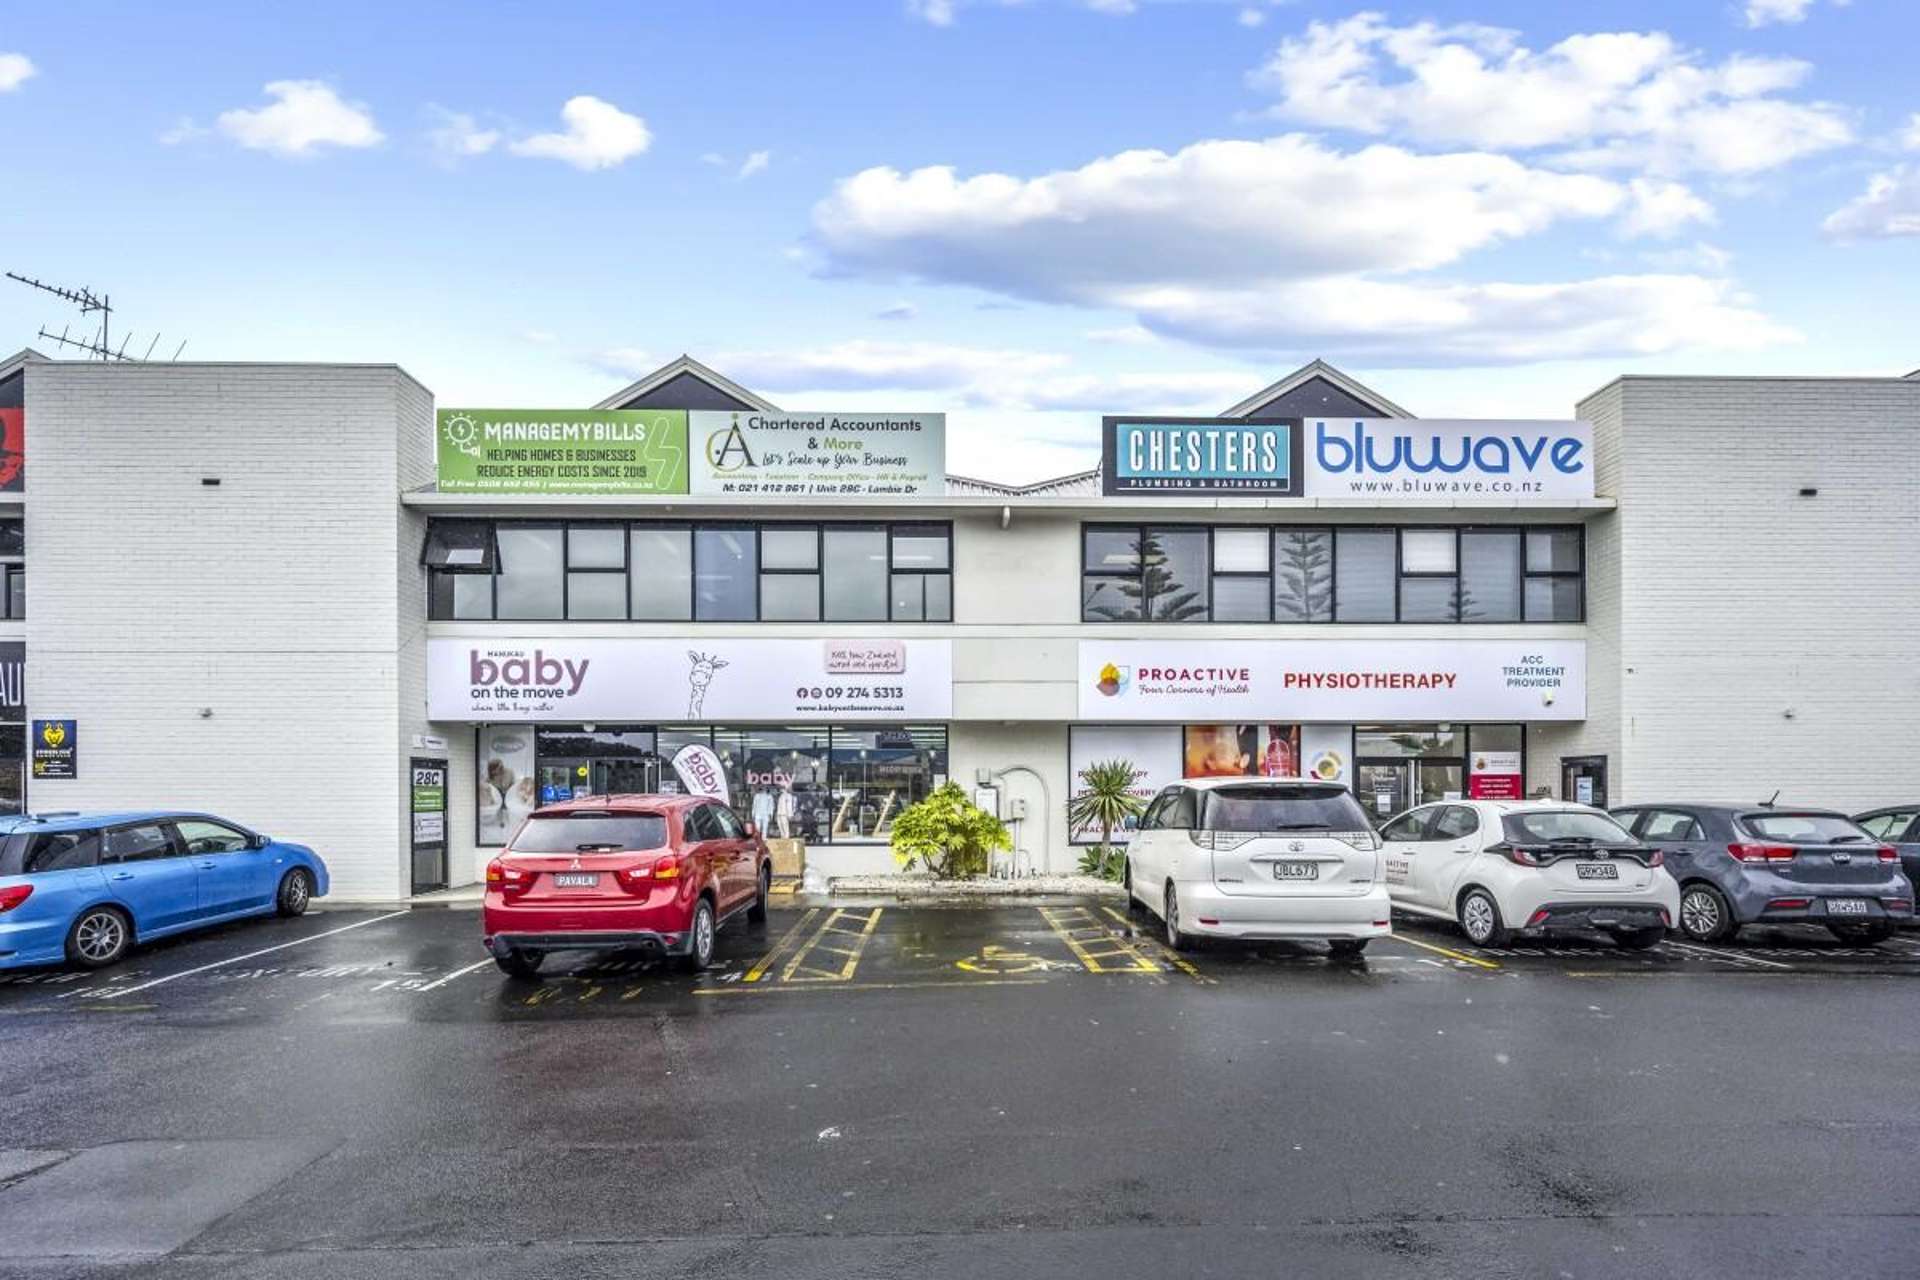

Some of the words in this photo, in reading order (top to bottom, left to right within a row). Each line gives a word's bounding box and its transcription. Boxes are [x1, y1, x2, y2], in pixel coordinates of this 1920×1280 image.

[748, 417, 825, 431] Chartered
[830, 418, 921, 432] Accountants
[484, 421, 646, 444] MANAGEMYBILLS
[807, 437, 818, 450] &
[823, 437, 864, 451] More
[1129, 430, 1278, 472] CHESTERS
[1316, 421, 1584, 475] bluwave
[487, 449, 527, 462] HELPING
[530, 449, 564, 462] HOMES
[575, 450, 636, 462] BUSINESSES
[816, 455, 831, 469] up
[863, 452, 908, 467] Business
[476, 465, 515, 478] REDUCE
[517, 465, 555, 478] ENERGY
[557, 466, 590, 478] COSTS
[592, 466, 622, 478] SINCE
[738, 484, 759, 492] 021
[816, 485, 838, 493] Unit
[905, 486, 918, 494] Dr
[1350, 479, 1543, 493] www.bluwave.co.nz
[1520, 655, 1543, 665] ACC
[470, 649, 590, 697] baby
[1138, 668, 1250, 681] PROACTIVE
[1502, 666, 1566, 677] TREATMENT
[1284, 672, 1457, 688] PHYSIOTHERAPY
[1506, 678, 1561, 688] PROVIDER
[471, 688, 490, 699] on
[493, 686, 519, 699] the
[522, 688, 564, 699] move
[825, 687, 844, 699] 09
[846, 687, 870, 699] 274
[872, 687, 904, 699] 5313
[1166, 684, 1204, 695] Corners
[1205, 684, 1217, 697] of
[1217, 684, 1250, 695] Health
[416, 771, 440, 785] 28C
[688, 751, 722, 794] baby
[746, 770, 796, 788] baby
